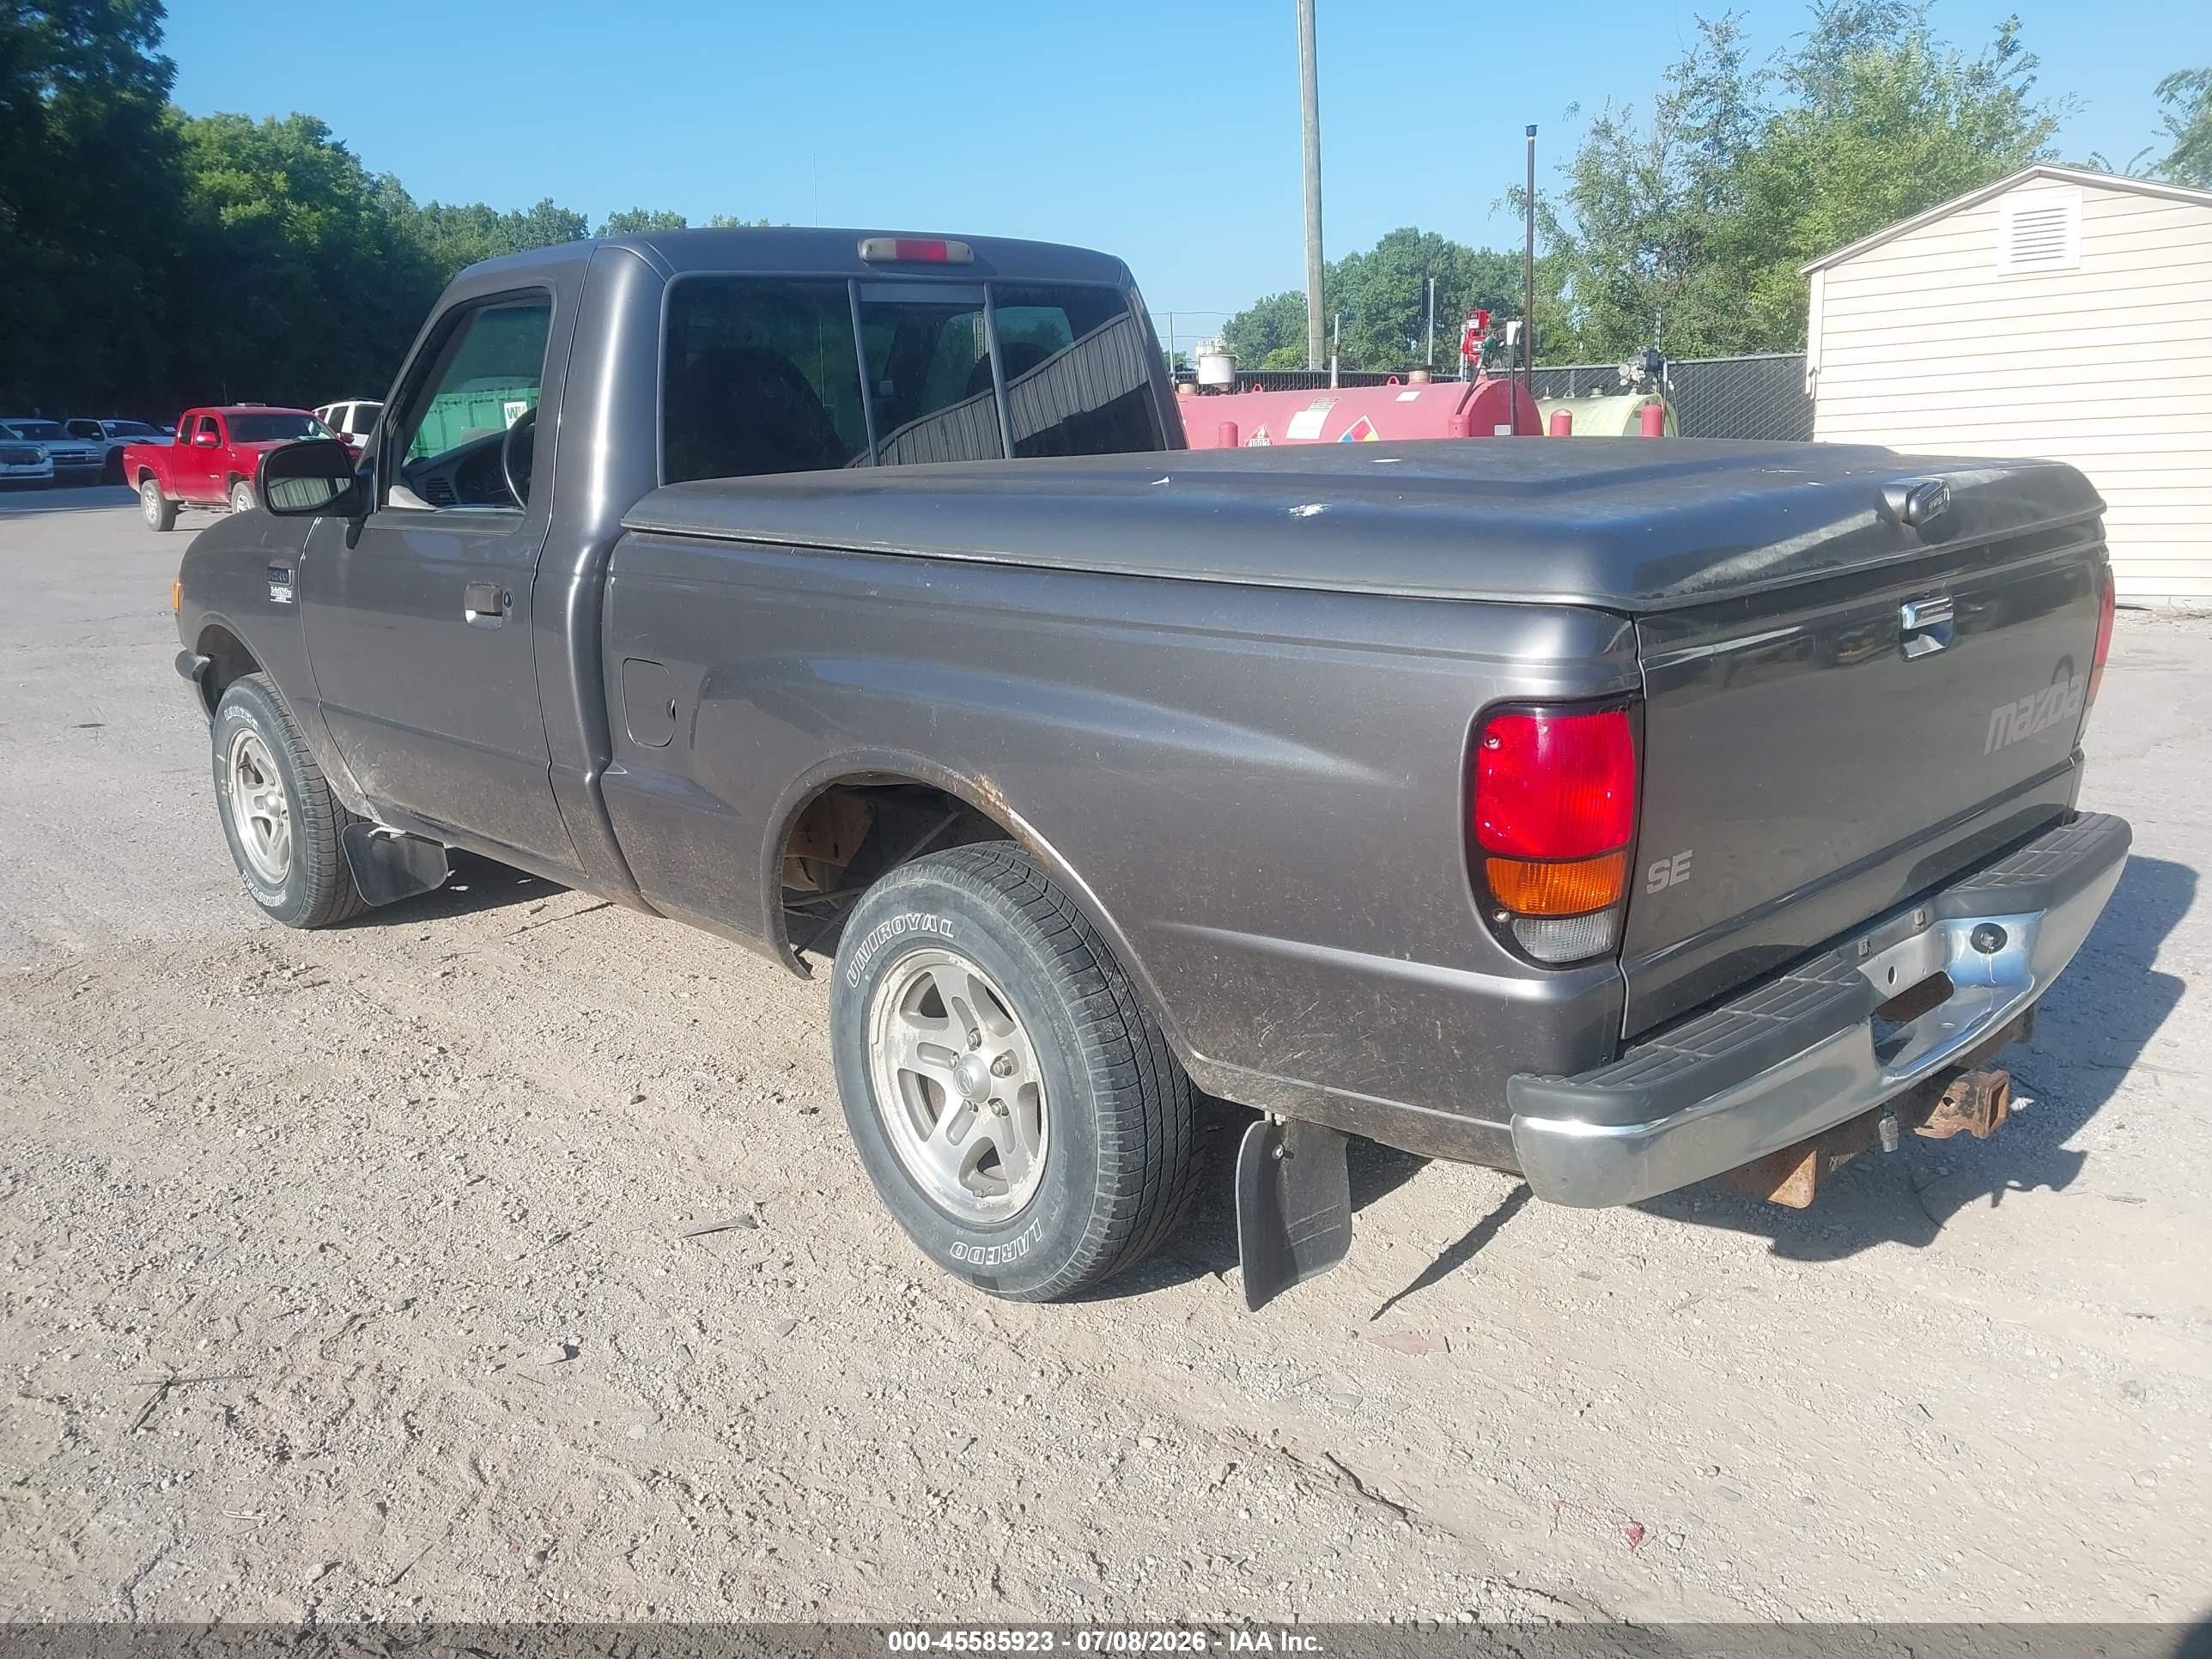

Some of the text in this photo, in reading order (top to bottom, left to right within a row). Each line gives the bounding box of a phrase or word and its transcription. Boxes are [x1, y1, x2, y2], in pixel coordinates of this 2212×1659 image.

[1984, 673, 2084, 757] mazda
[242, 869, 286, 908] UNIROYAL
[1646, 849, 1693, 895] SE
[847, 913, 954, 988] UNIROYAL
[950, 1217, 1042, 1265] LAREDO
